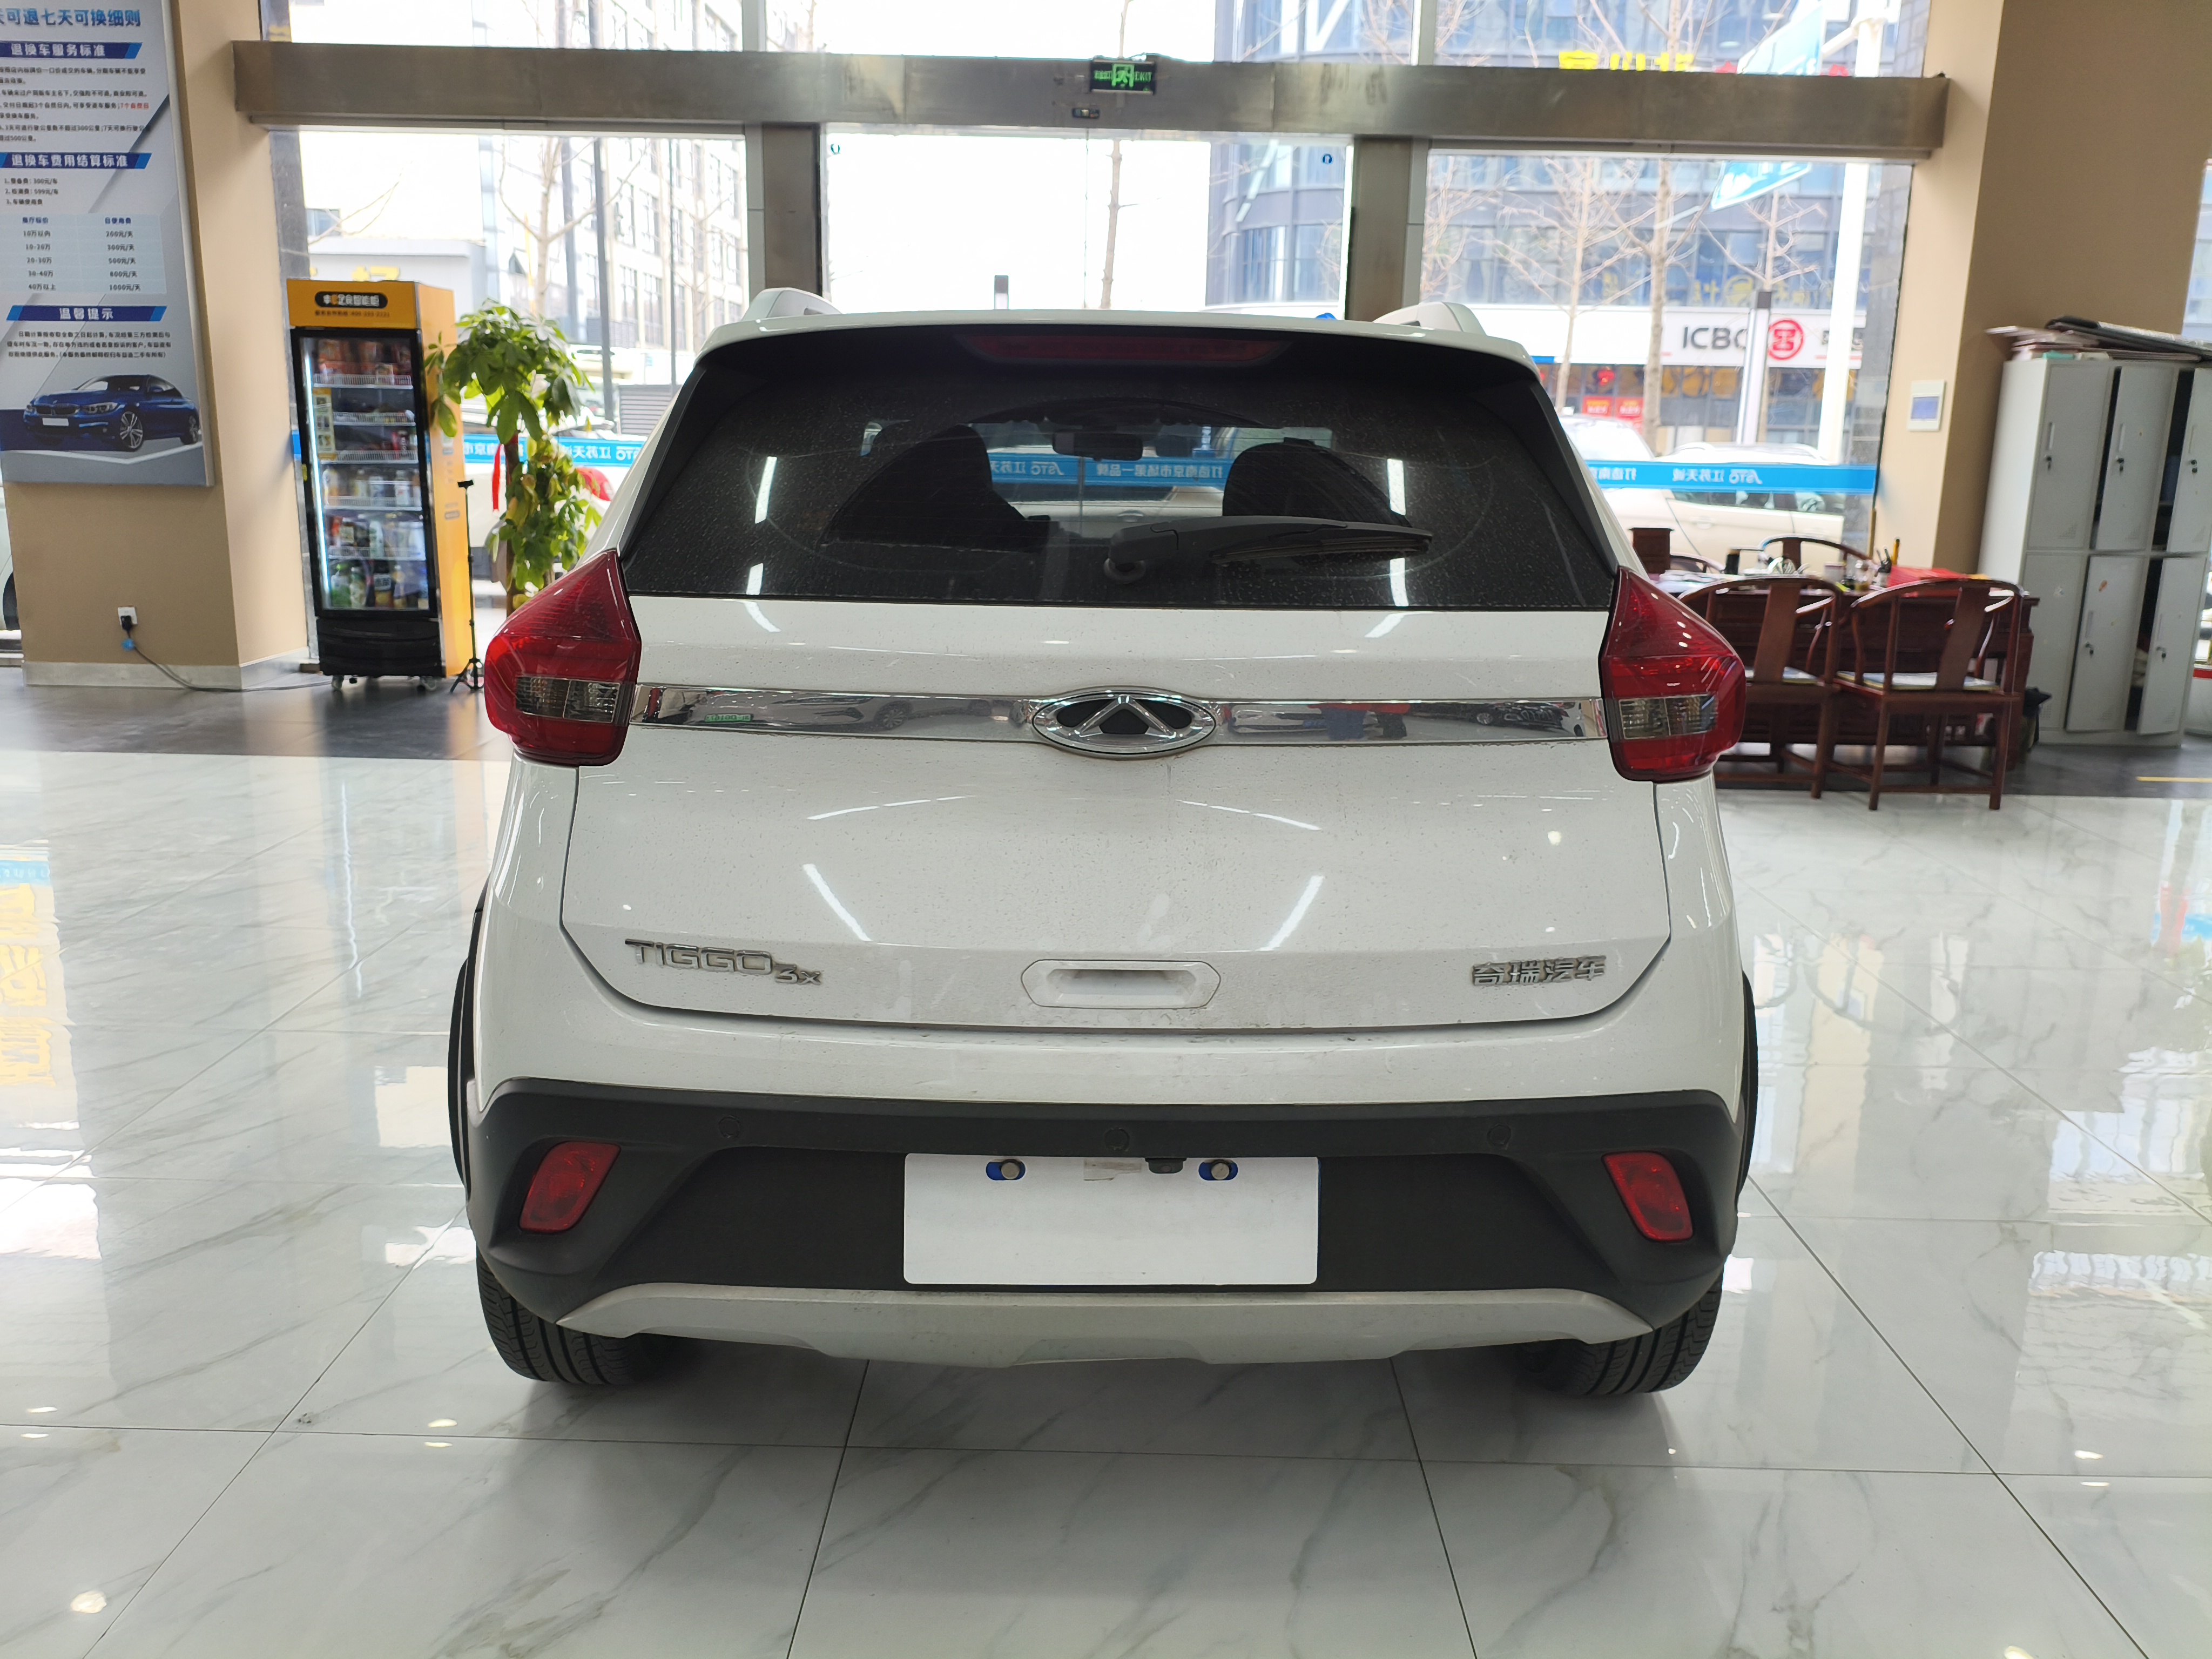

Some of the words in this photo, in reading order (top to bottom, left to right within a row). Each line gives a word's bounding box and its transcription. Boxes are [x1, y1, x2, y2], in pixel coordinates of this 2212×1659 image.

[11, 43, 106, 57] 退换车服务标准
[11, 154, 128, 167] 退换车费用结算标准
[59, 307, 113, 320] 温馨提示
[625, 938, 773, 975] TIGGO
[1472, 955, 1607, 986] 奇瑞汽车
